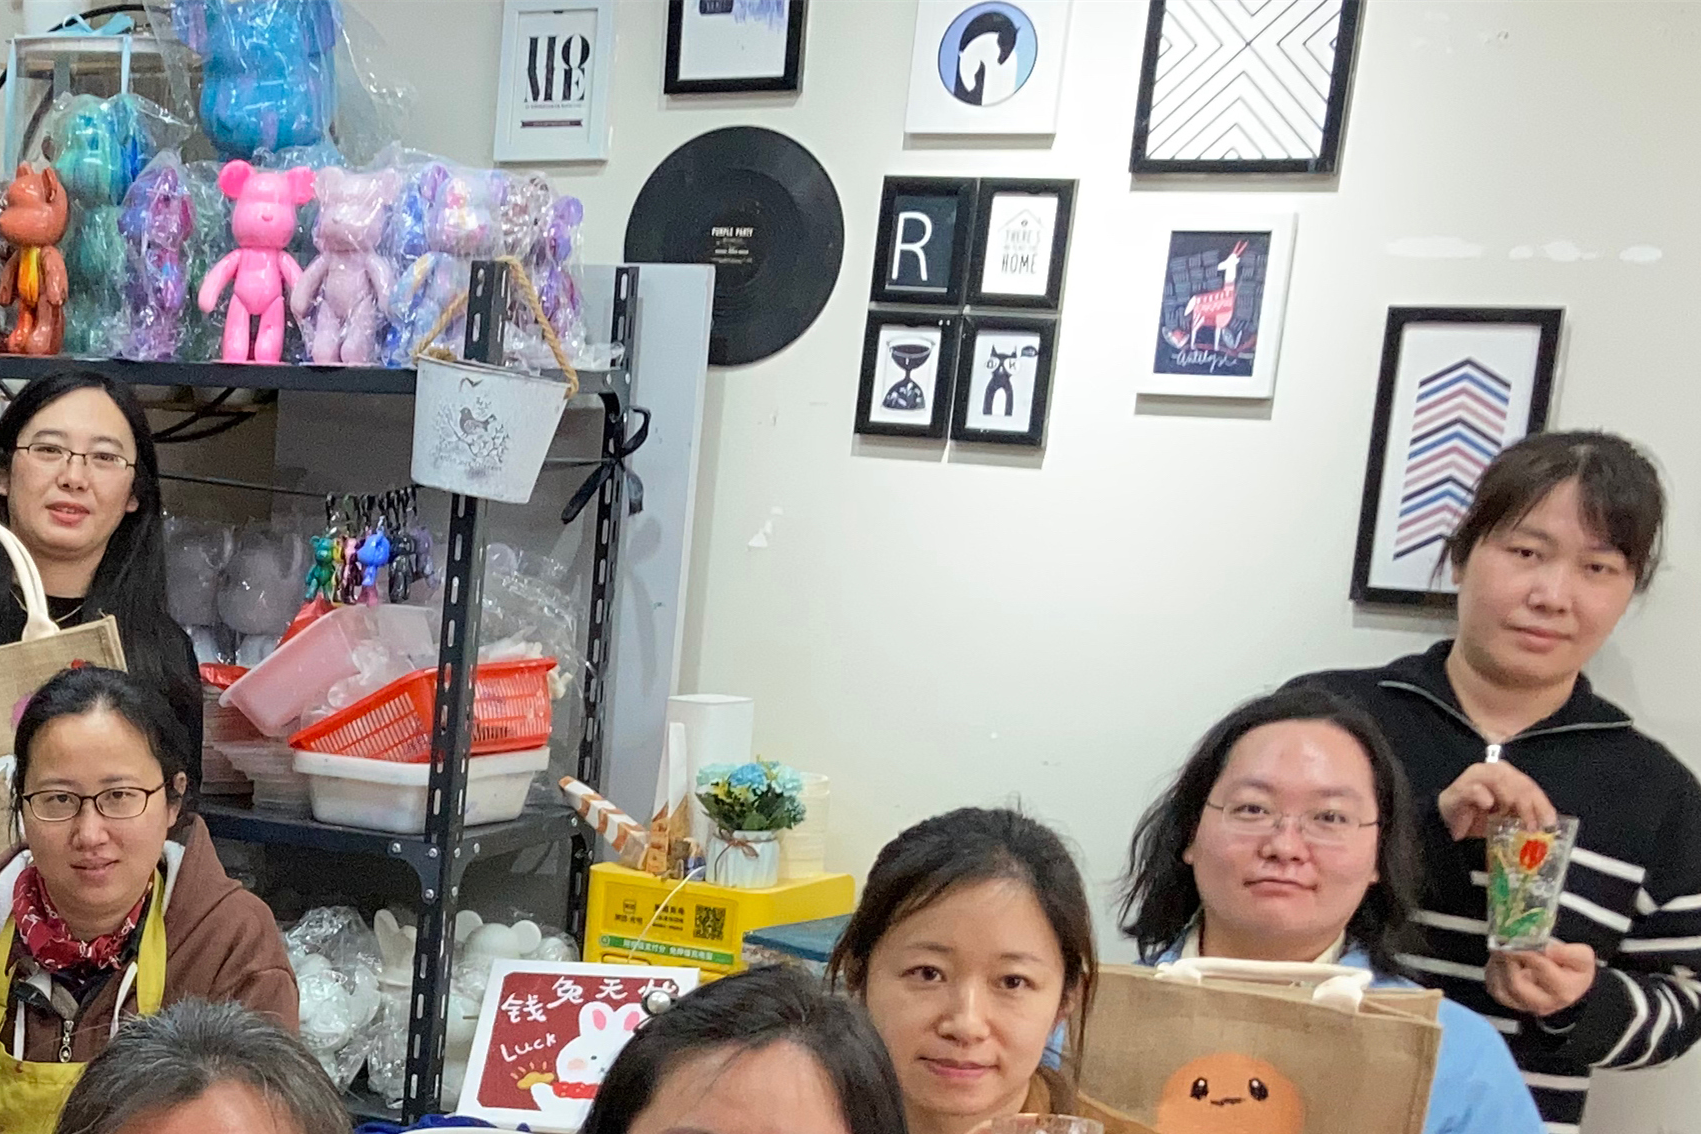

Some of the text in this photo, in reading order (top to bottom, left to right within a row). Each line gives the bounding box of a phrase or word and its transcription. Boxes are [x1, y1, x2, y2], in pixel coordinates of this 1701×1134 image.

[891, 210, 933, 282] R
[1001, 252, 1039, 275] HOME
[500, 1033, 557, 1062] Luck
